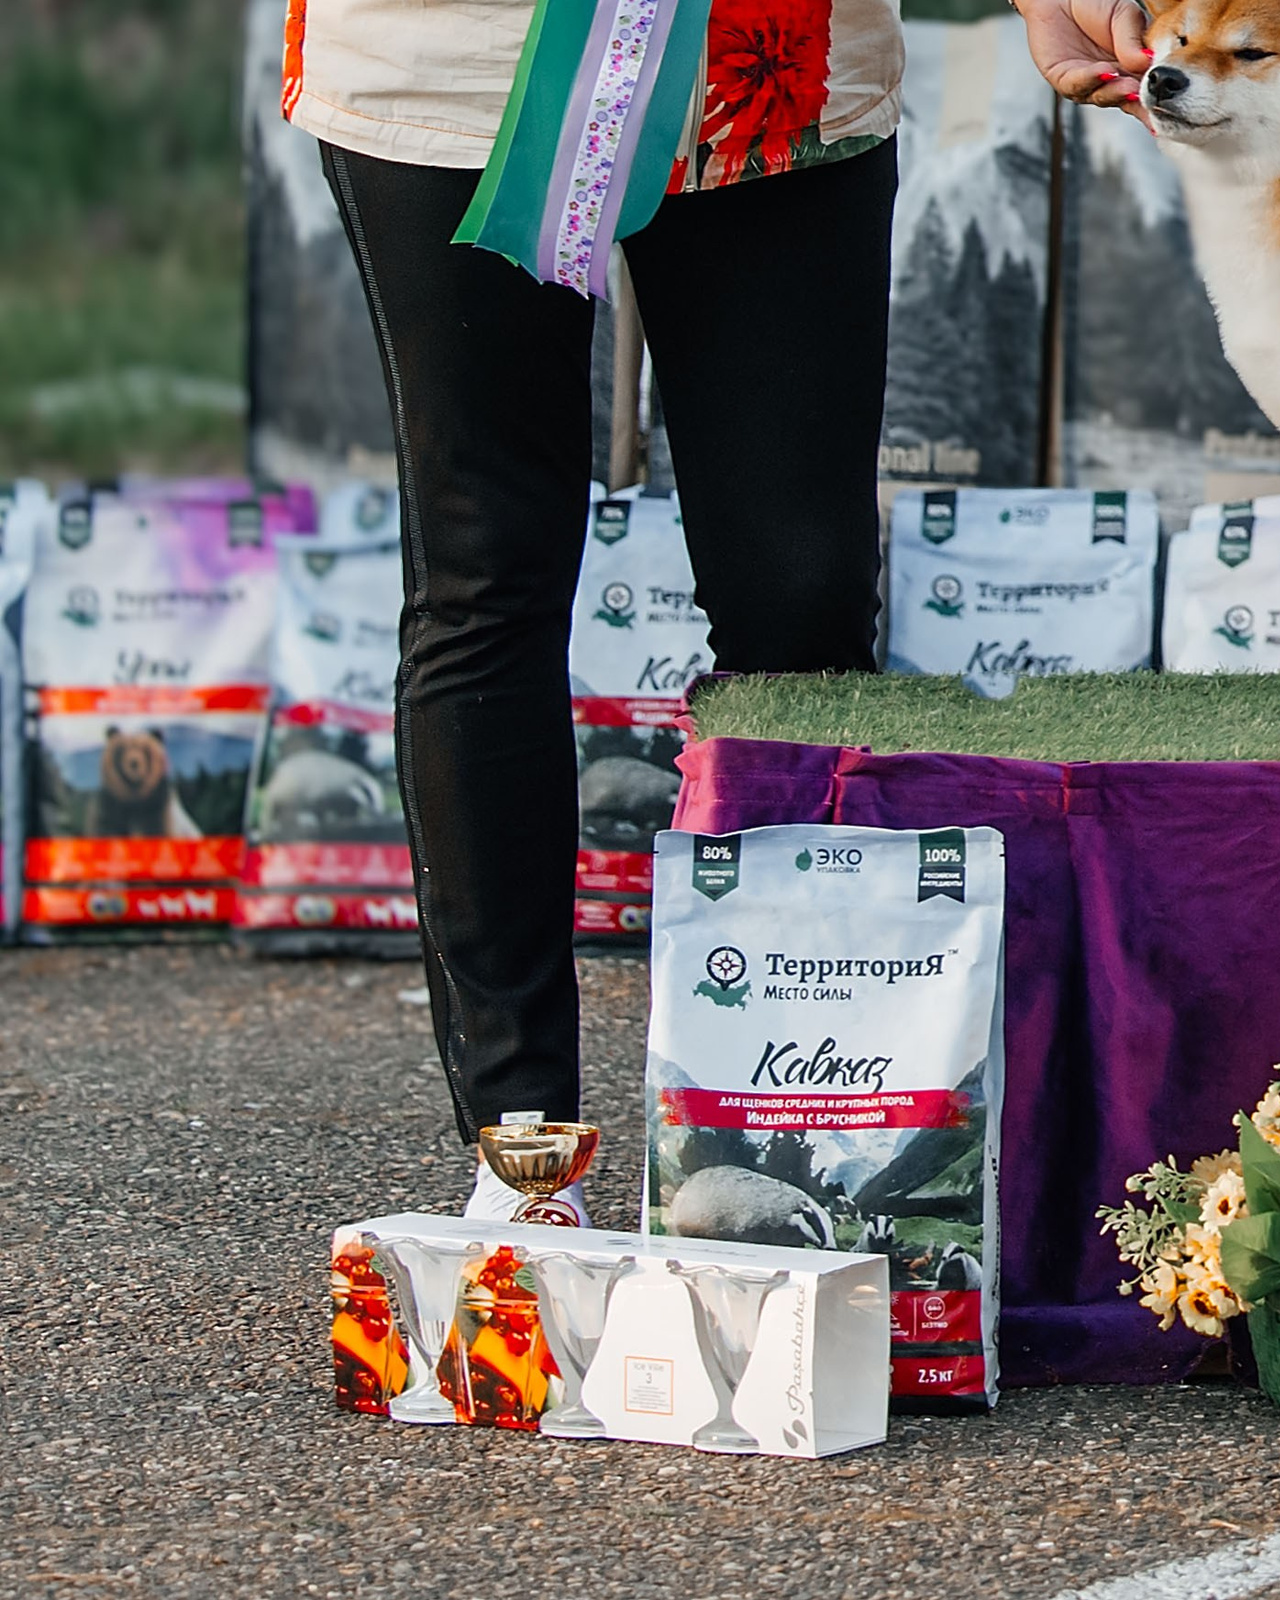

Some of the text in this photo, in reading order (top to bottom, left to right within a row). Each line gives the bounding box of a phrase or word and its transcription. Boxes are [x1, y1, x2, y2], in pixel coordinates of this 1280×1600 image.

[702, 846, 732, 860] 80%
[817, 848, 862, 865] ЭКО
[925, 849, 961, 862] 100%
[765, 953, 945, 984] ТерриториЯ
[751, 1037, 893, 1093] Кавказ
[719, 1096, 915, 1108] ДЛЯ ЩЕНКОВ СРЕДНИХ И КРУПНЫХ ПОРОД
[747, 1111, 804, 1125] ИНДЕЙКА
[815, 1109, 885, 1125] БРУСНИКОЙ
